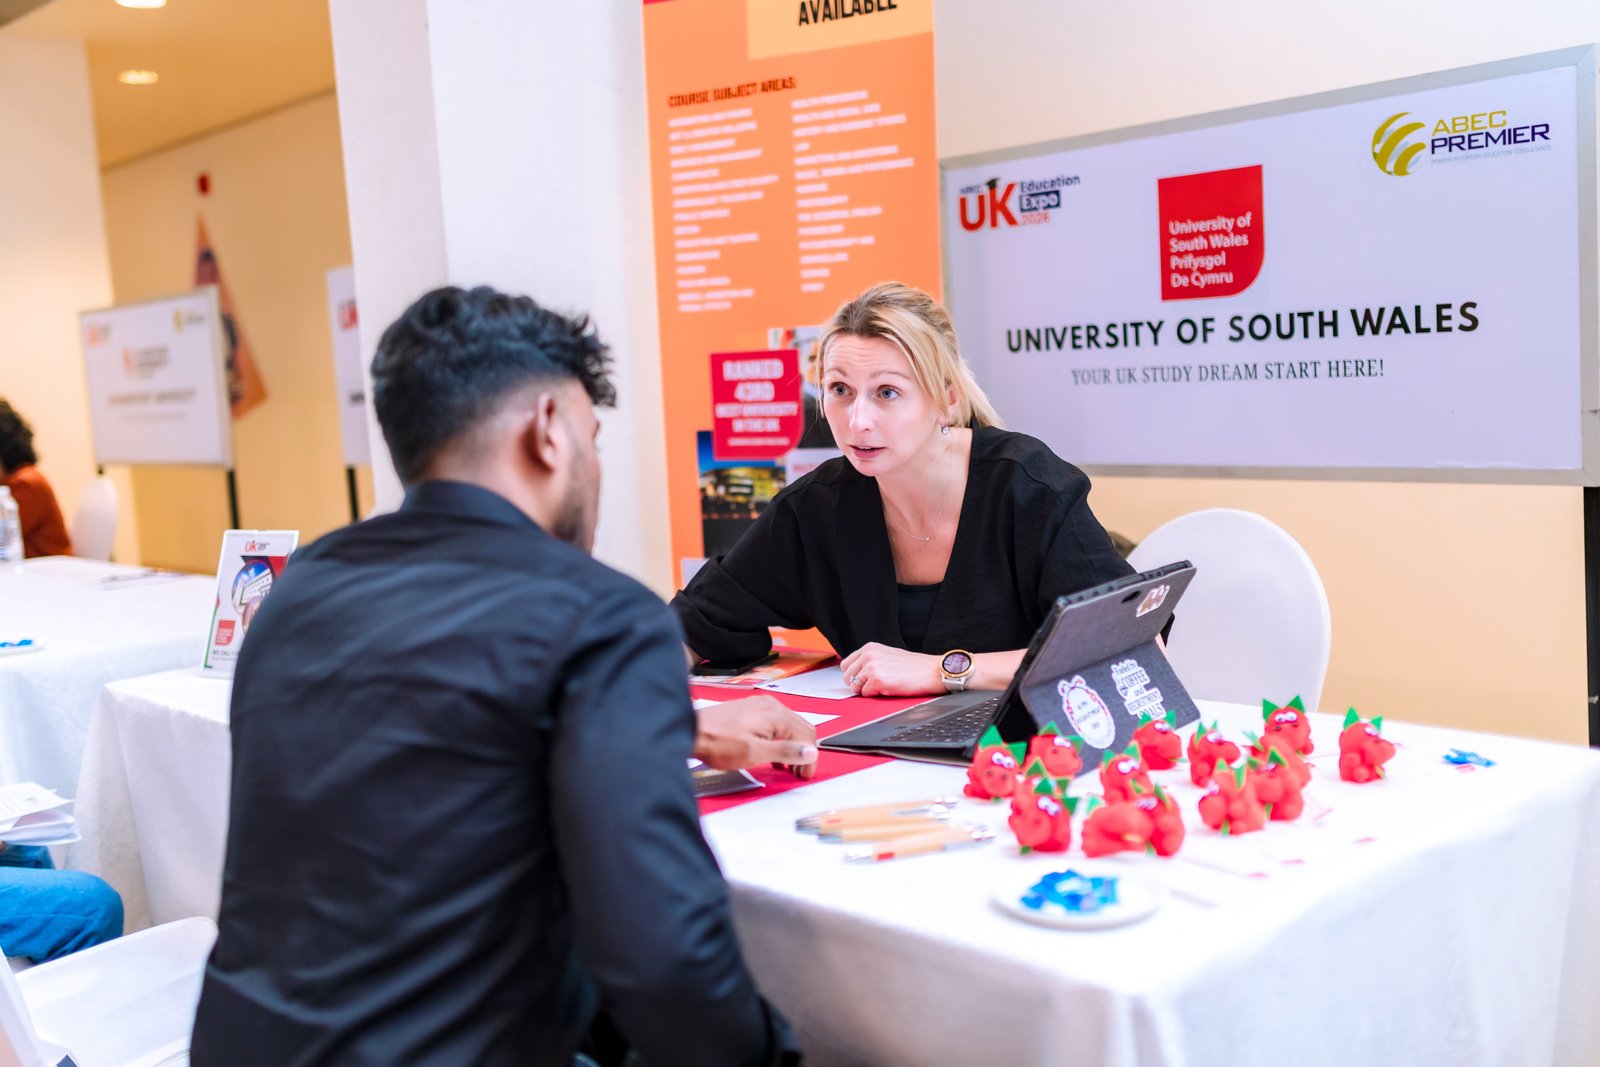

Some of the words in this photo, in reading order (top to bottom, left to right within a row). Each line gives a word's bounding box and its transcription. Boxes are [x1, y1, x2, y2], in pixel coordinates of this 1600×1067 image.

[1432, 110, 1507, 137] ABEC
[1431, 123, 1551, 155] PREMIER
[1020, 175, 1081, 193] Education
[960, 182, 1018, 231] UK
[1022, 193, 1058, 210] Expo
[1168, 215, 1235, 235] University
[1236, 211, 1252, 228] of
[1169, 236, 1208, 253] South
[1209, 232, 1249, 249] Wales
[1170, 250, 1226, 271] Prifysgol
[1171, 273, 1189, 288] De
[1190, 271, 1234, 289] Cymru
[1007, 320, 1164, 353] UNIVERSITY
[1176, 317, 1215, 345] OF
[1228, 309, 1339, 342] SOUTH
[1351, 301, 1479, 336] WALES
[1071, 367, 1111, 386] YOUR
[1116, 367, 1137, 384] UK
[1142, 365, 1193, 384] STUDY
[1198, 363, 1258, 383] DREAM
[1264, 360, 1321, 381] START
[1328, 359, 1384, 379] HERE!
[1120, 669, 1149, 688] COFFEE
